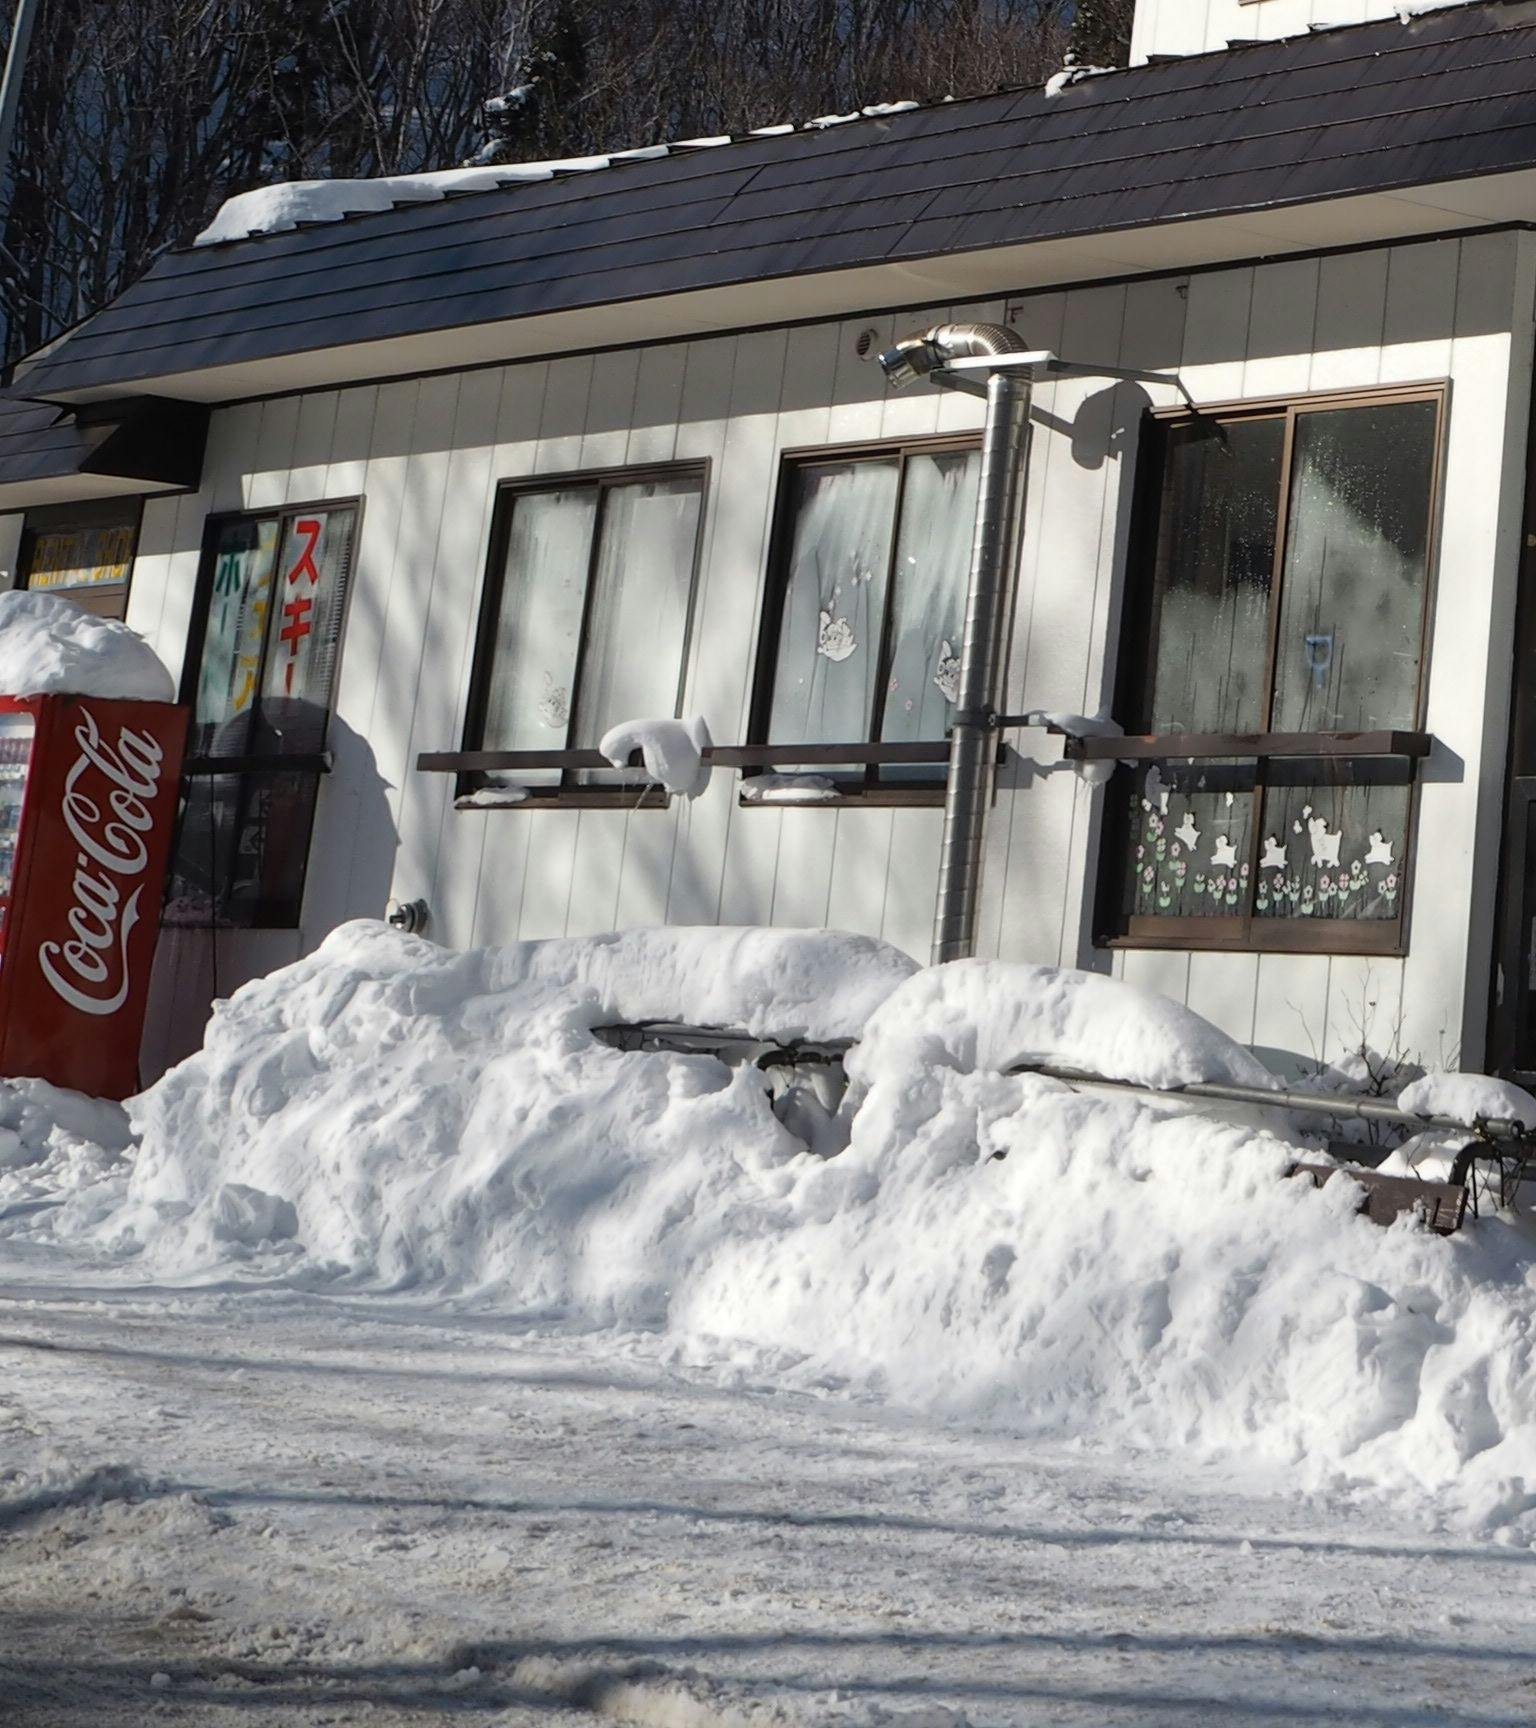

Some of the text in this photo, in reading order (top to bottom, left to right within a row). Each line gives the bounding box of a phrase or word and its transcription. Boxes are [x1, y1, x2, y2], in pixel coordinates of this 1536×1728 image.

[279, 519, 321, 697] スキー
[38, 705, 164, 1016] Coca-Cola
